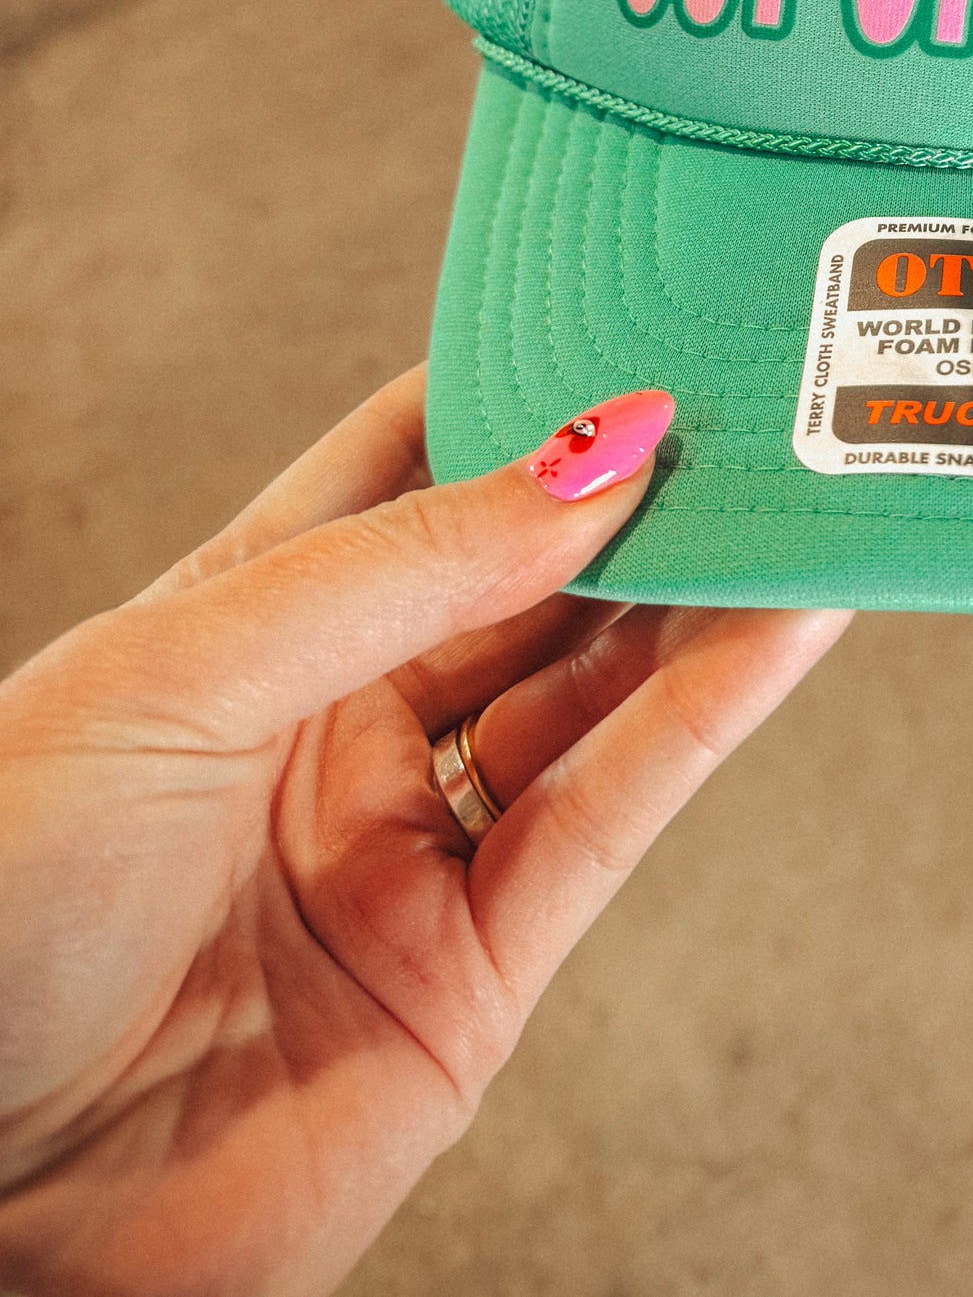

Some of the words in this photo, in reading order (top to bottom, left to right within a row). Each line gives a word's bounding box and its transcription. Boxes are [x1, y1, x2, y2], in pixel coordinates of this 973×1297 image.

[877, 222, 956, 234] PREMIUM
[821, 254, 845, 340] SWEATBAND
[857, 318, 961, 337] WORLD
[877, 338, 961, 355] FOAM
[814, 341, 834, 388] CLOTH
[806, 392, 827, 436] TERRY
[844, 452, 929, 466] DURABLE
